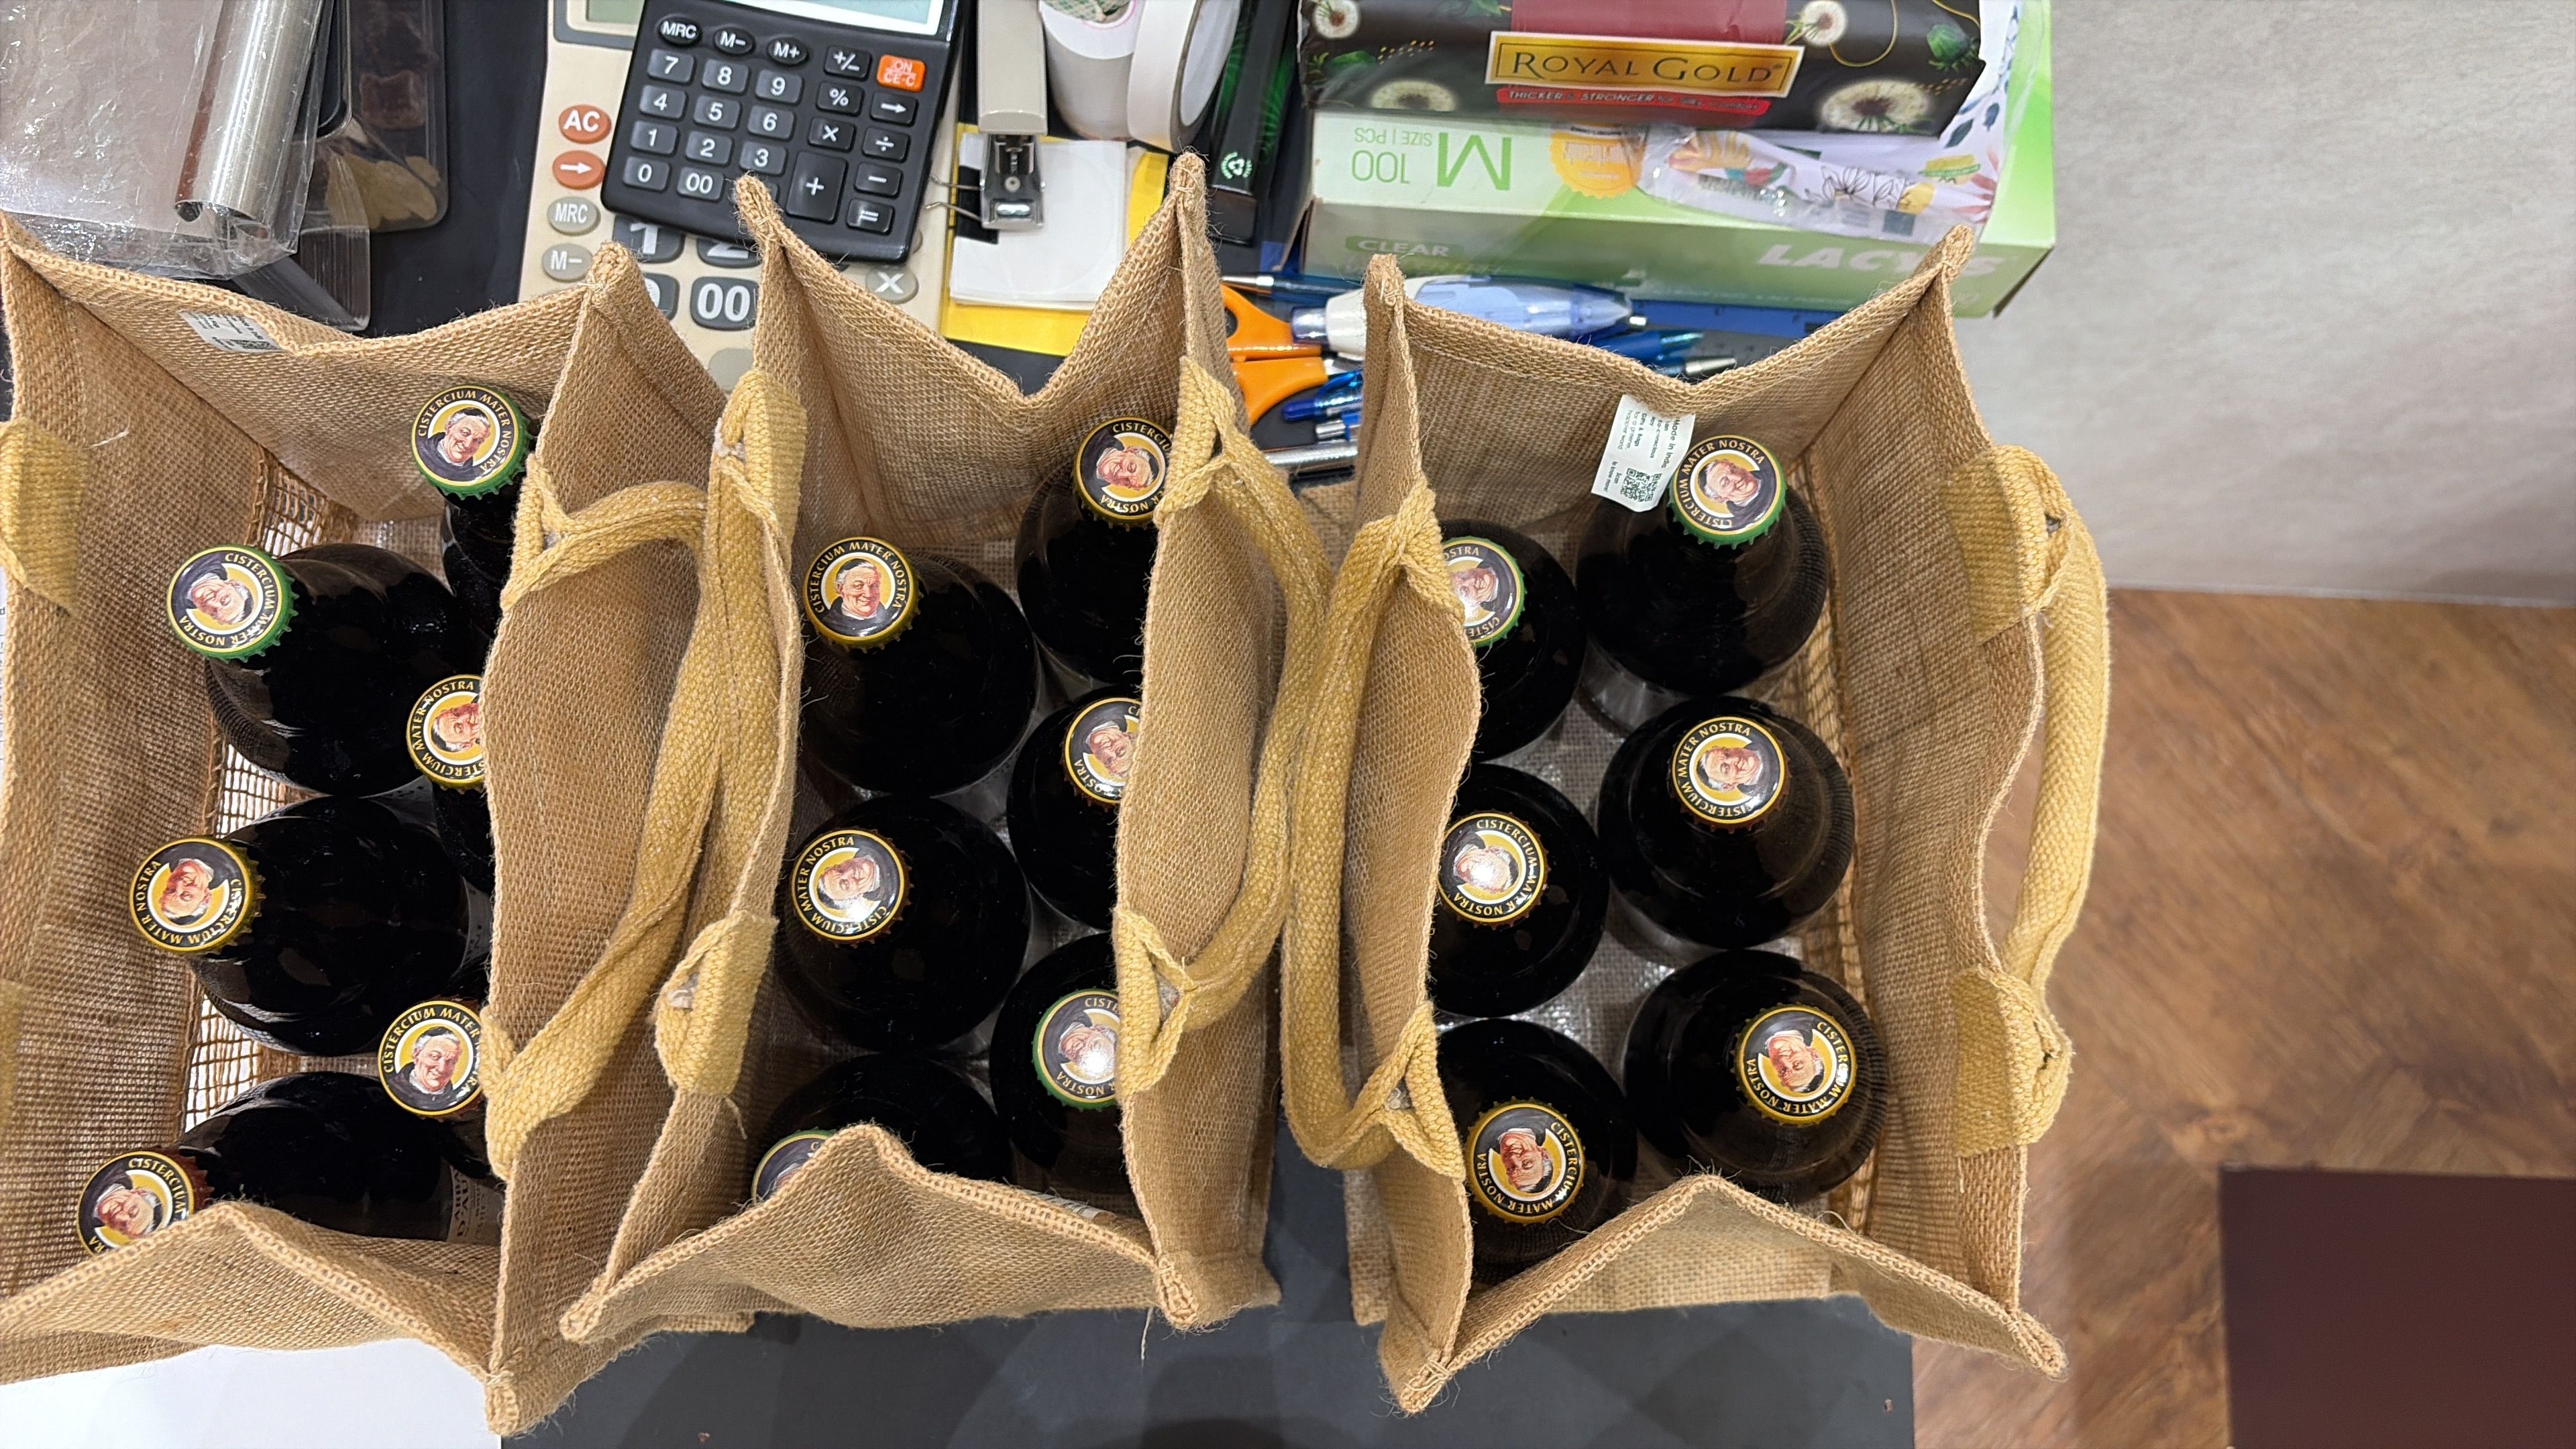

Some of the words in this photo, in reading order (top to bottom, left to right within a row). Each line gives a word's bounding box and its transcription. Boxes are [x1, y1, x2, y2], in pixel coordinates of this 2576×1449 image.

[661, 21, 697, 39] MRC
[720, 31, 746, 48] M-
[773, 41, 800, 59] M+
[664, 55, 678, 74] 7
[717, 66, 732, 85] 8
[1513, 52, 1640, 80] ROYAL
[771, 76, 786, 96] 9
[828, 88, 849, 107] %
[1509, 91, 1564, 100] THICKER
[1580, 93, 1655, 102] STRONGER
[653, 93, 667, 111] 4
[708, 102, 723, 121] 5
[564, 109, 600, 132] AC
[763, 113, 777, 131] 6
[648, 128, 657, 146] 1
[700, 138, 715, 158] 2
[1354, 127, 1387, 144] PCS
[1402, 131, 1433, 147] SIZE
[754, 148, 769, 167] 3
[1351, 150, 1410, 184] 100
[1436, 131, 1512, 191] M
[638, 164, 652, 182] 0
[686, 172, 713, 194] 00
[555, 203, 588, 224] MRC
[630, 222, 658, 254] 1
[1358, 239, 1449, 257] CLEAR
[551, 250, 582, 270] M-
[1757, 244, 2006, 276] LACYS
[698, 283, 751, 322] 00
[418, 390, 476, 437] CISTERCIUM
[480, 394, 511, 427] MATER
[1112, 423, 1172, 452] CISTERCIU
[479, 431, 512, 472] NOSTRA
[1682, 443, 1715, 476] MATER
[1719, 439, 1766, 464] NOSTRA
[1100, 494, 1149, 513] NOSTRA
[1679, 478, 1733, 527] CISTERCIUM
[1443, 546, 1481, 561] OSTRA
[225, 553, 276, 610] CISTERCIUM
[810, 545, 845, 614] CISTERCIUM
[849, 541, 892, 561] MATER
[890, 561, 907, 609] NOSTRA
[179, 615, 226, 646] NOSTRA
[231, 612, 274, 645] MER
[423, 680, 474, 704] NOSTRA
[412, 708, 427, 751] MATER
[1678, 737, 1700, 778] MATER
[1699, 722, 1752, 738] NOSTRA
[421, 752, 486, 777] STERCIUM
[1074, 759, 1110, 796] OSTRA
[805, 836, 855, 865] NOSTRA
[1476, 819, 1538, 867] CISTERCIUM
[136, 860, 162, 912] NOSTRA
[798, 868, 814, 912] MATER
[1454, 892, 1504, 916] NOSTRA
[141, 914, 184, 945] MATER
[810, 906, 888, 934] CISTECIUM
[383, 1008, 436, 1073] CISTERCIUM
[439, 1007, 481, 1038] MATER
[1816, 1021, 1849, 1098] CISTERCUM
[1057, 1071, 1106, 1096] NOSTRA
[1746, 1058, 1779, 1107] NOSTRA
[1782, 1095, 1832, 1114] MATER
[128, 1157, 187, 1214] CISTERCIUM
[1477, 1152, 1505, 1204] NOSTRA
[1507, 1198, 1554, 1214] MATER
